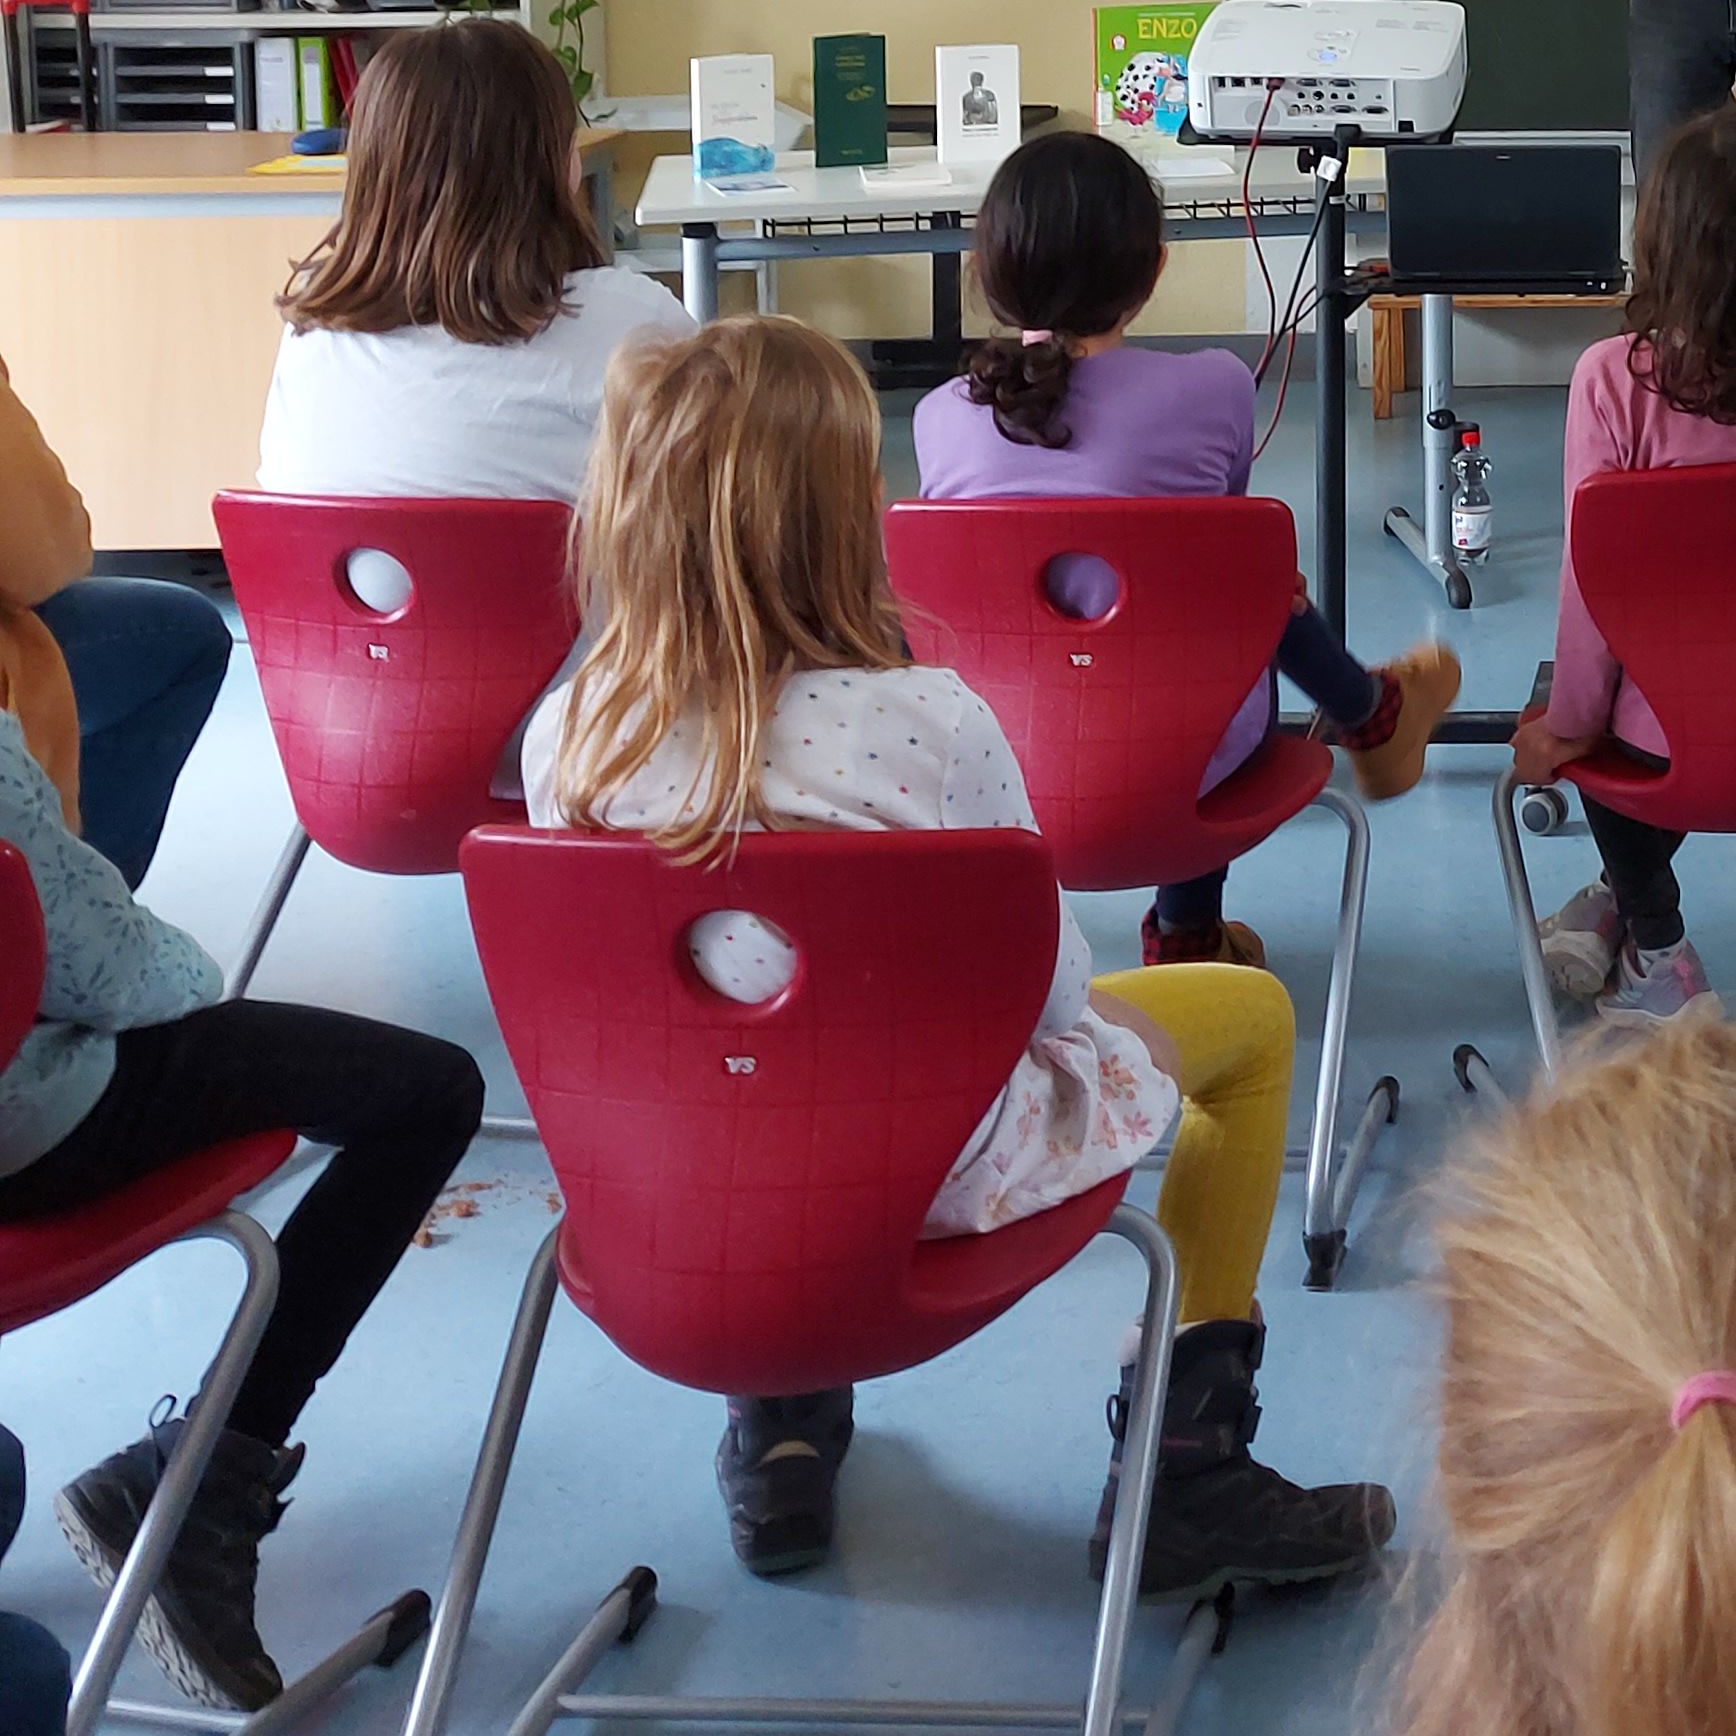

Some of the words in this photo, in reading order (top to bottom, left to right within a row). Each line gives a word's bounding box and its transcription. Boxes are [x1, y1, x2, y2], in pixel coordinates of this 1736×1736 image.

[1137, 18, 1198, 39] ENZO
[1070, 654, 1093, 666] VS
[725, 1057, 757, 1074] VS
